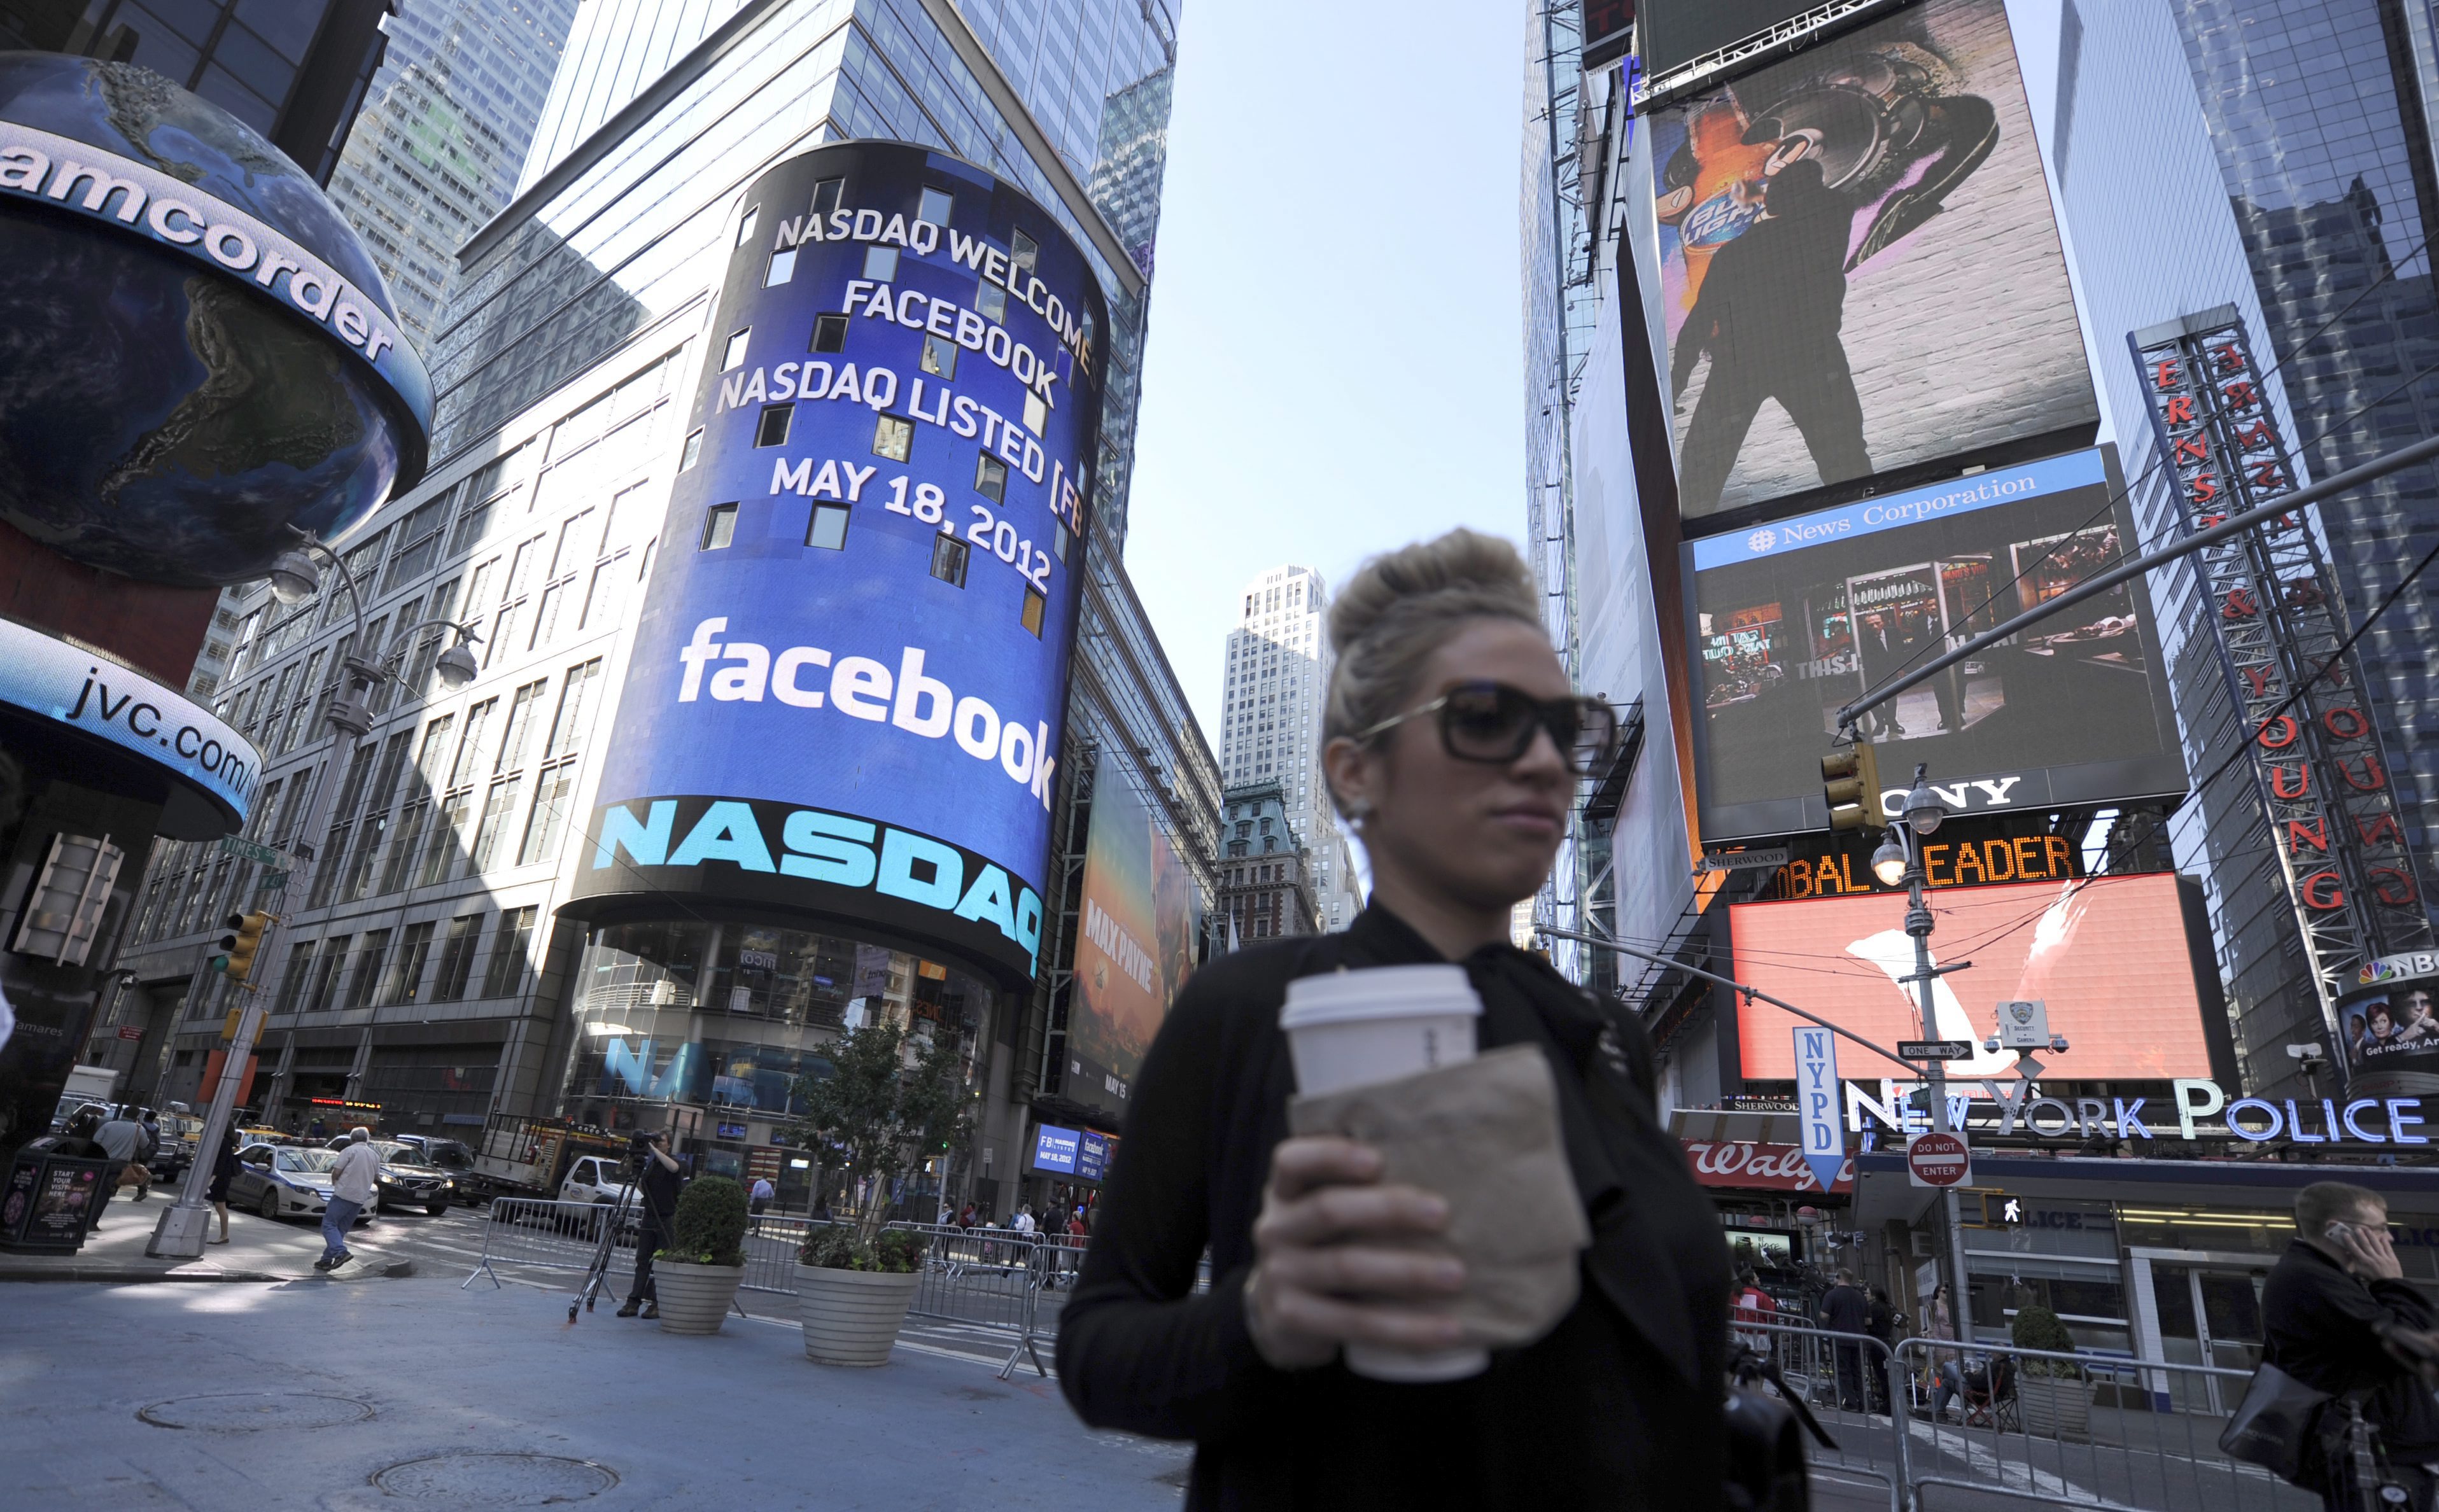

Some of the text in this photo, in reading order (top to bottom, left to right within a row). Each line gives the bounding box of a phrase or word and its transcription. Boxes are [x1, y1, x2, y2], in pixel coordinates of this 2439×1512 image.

[1588, 59, 1623, 77] SHERW
[775, 208, 938, 256] NASDAQ
[843, 280, 1056, 410] FACEBOOK
[715, 361, 896, 414] NASDAQ
[908, 377, 1044, 483] LISTED
[770, 458, 1051, 594] MAY 18, 2012
[1783, 473, 2037, 546] News Corporation
[678, 617, 1055, 813] facebook
[2223, 588, 2256, 619] &
[2242, 665, 2344, 909] YOUNG
[1846, 776, 2021, 817] ONY
[225, 837, 278, 859] TIMES SQ
[1708, 851, 1785, 870] SHERWOOD
[1923, 836, 2074, 885] EADER
[593, 799, 1043, 979] NASDAQ
[1085, 897, 1120, 962] MAX
[1118, 930, 1153, 994] PAYNE
[2393, 954, 2439, 977] NB
[15, 1019, 64, 1037] amares
[1939, 1046, 1961, 1054] WAY
[2366, 1046, 2382, 1056] Get
[2385, 1040, 2421, 1053] ready,
[1105, 1074, 1119, 1095] MAY
[1119, 1082, 1127, 1099] 15
[1804, 1032, 1832, 1151] NYPD
[1734, 1100, 1800, 1112] SHERWOOD
[1981, 1079, 2153, 1138] YORK
[2173, 1079, 2429, 1144] POLICE
[1039, 1151, 1051, 1160] MAY
[1917, 1142, 1956, 1152] DO NOT
[1923, 1166, 1957, 1176] ENTER
[2025, 1210, 2084, 1230] LICE
